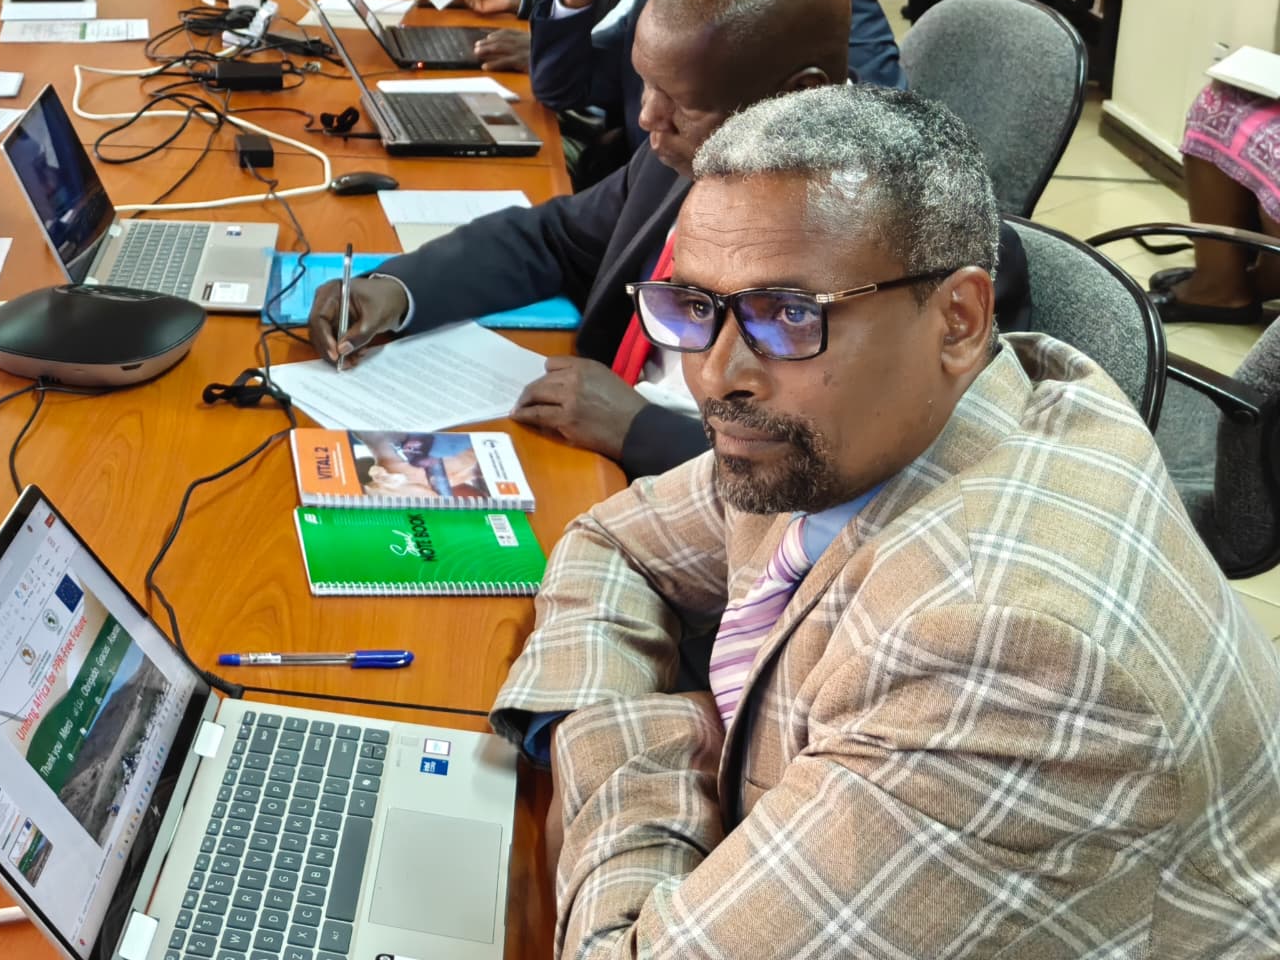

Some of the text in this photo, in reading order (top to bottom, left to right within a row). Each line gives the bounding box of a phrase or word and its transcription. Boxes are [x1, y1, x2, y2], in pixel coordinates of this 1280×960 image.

[314, 454, 333, 480] VITAL
[407, 514, 437, 562] NOTE BOOK
[32, 680, 51, 711] Africa
[45, 668, 57, 687] for
[70, 612, 88, 642] Future
[40, 751, 56, 778] Thank
[51, 739, 64, 760] you
